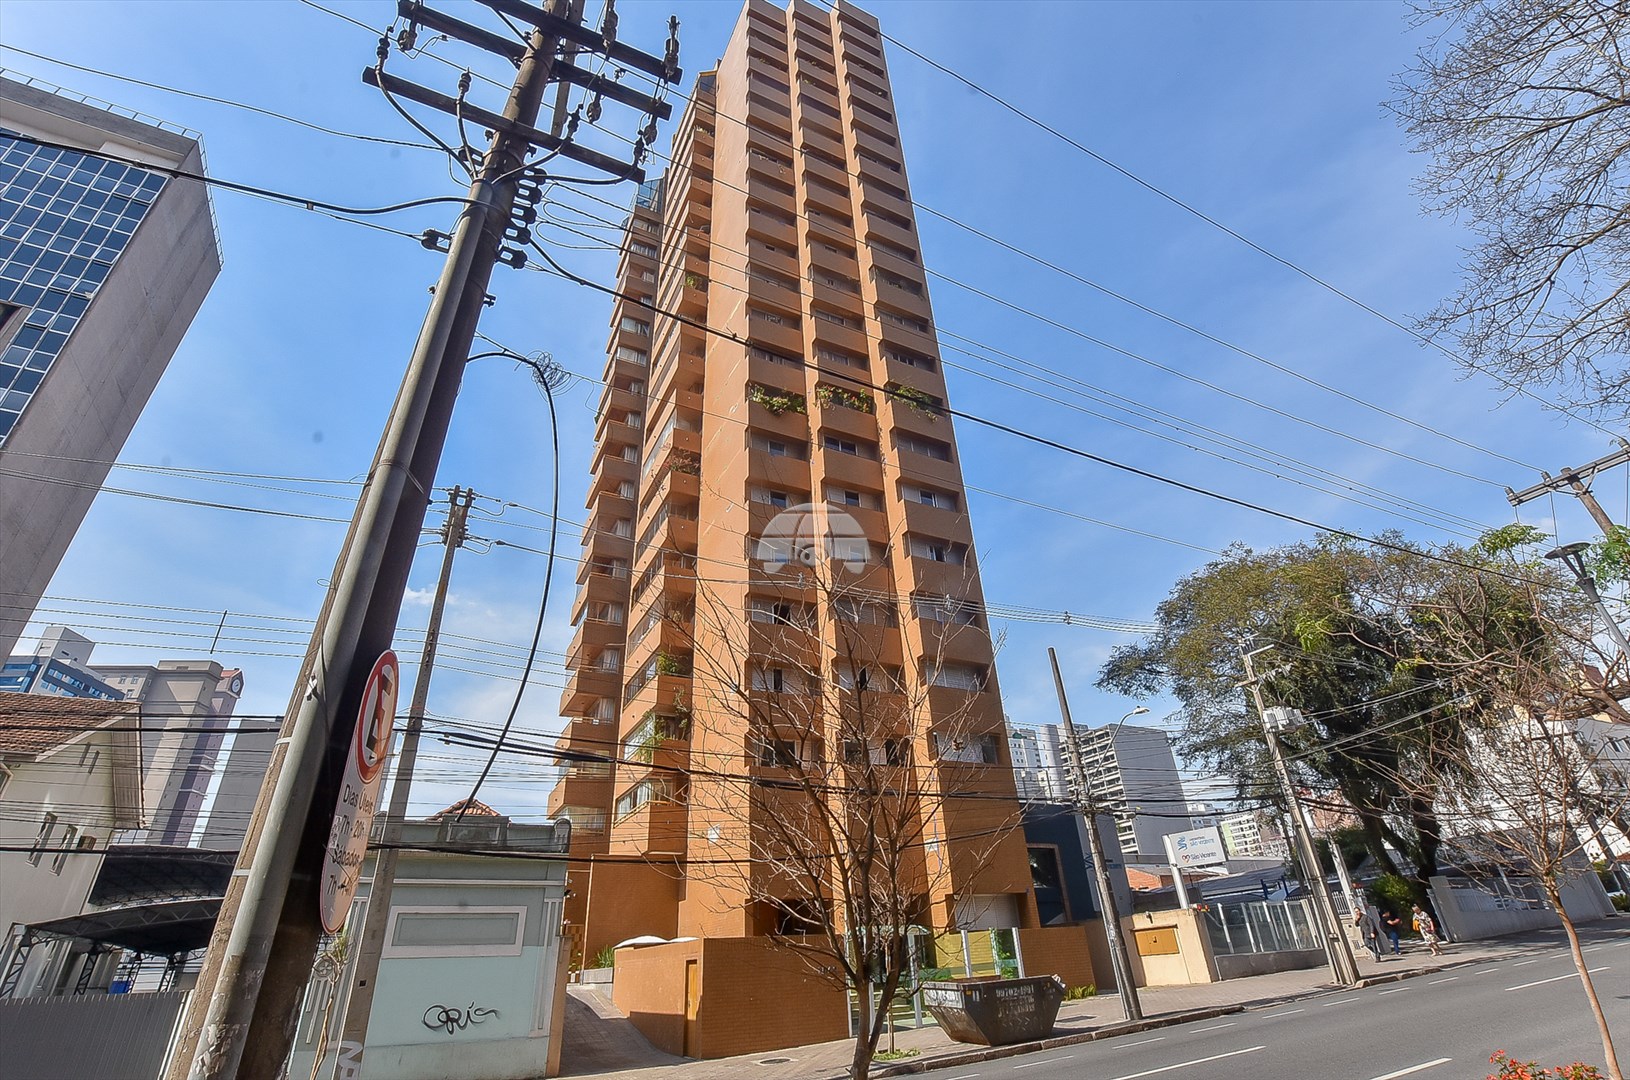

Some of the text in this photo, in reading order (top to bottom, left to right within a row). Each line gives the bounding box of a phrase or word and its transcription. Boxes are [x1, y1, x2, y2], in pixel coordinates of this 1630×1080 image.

[343, 784, 359, 808] Dias
[341, 815, 350, 835] 7h
[327, 874, 337, 896] 7h
